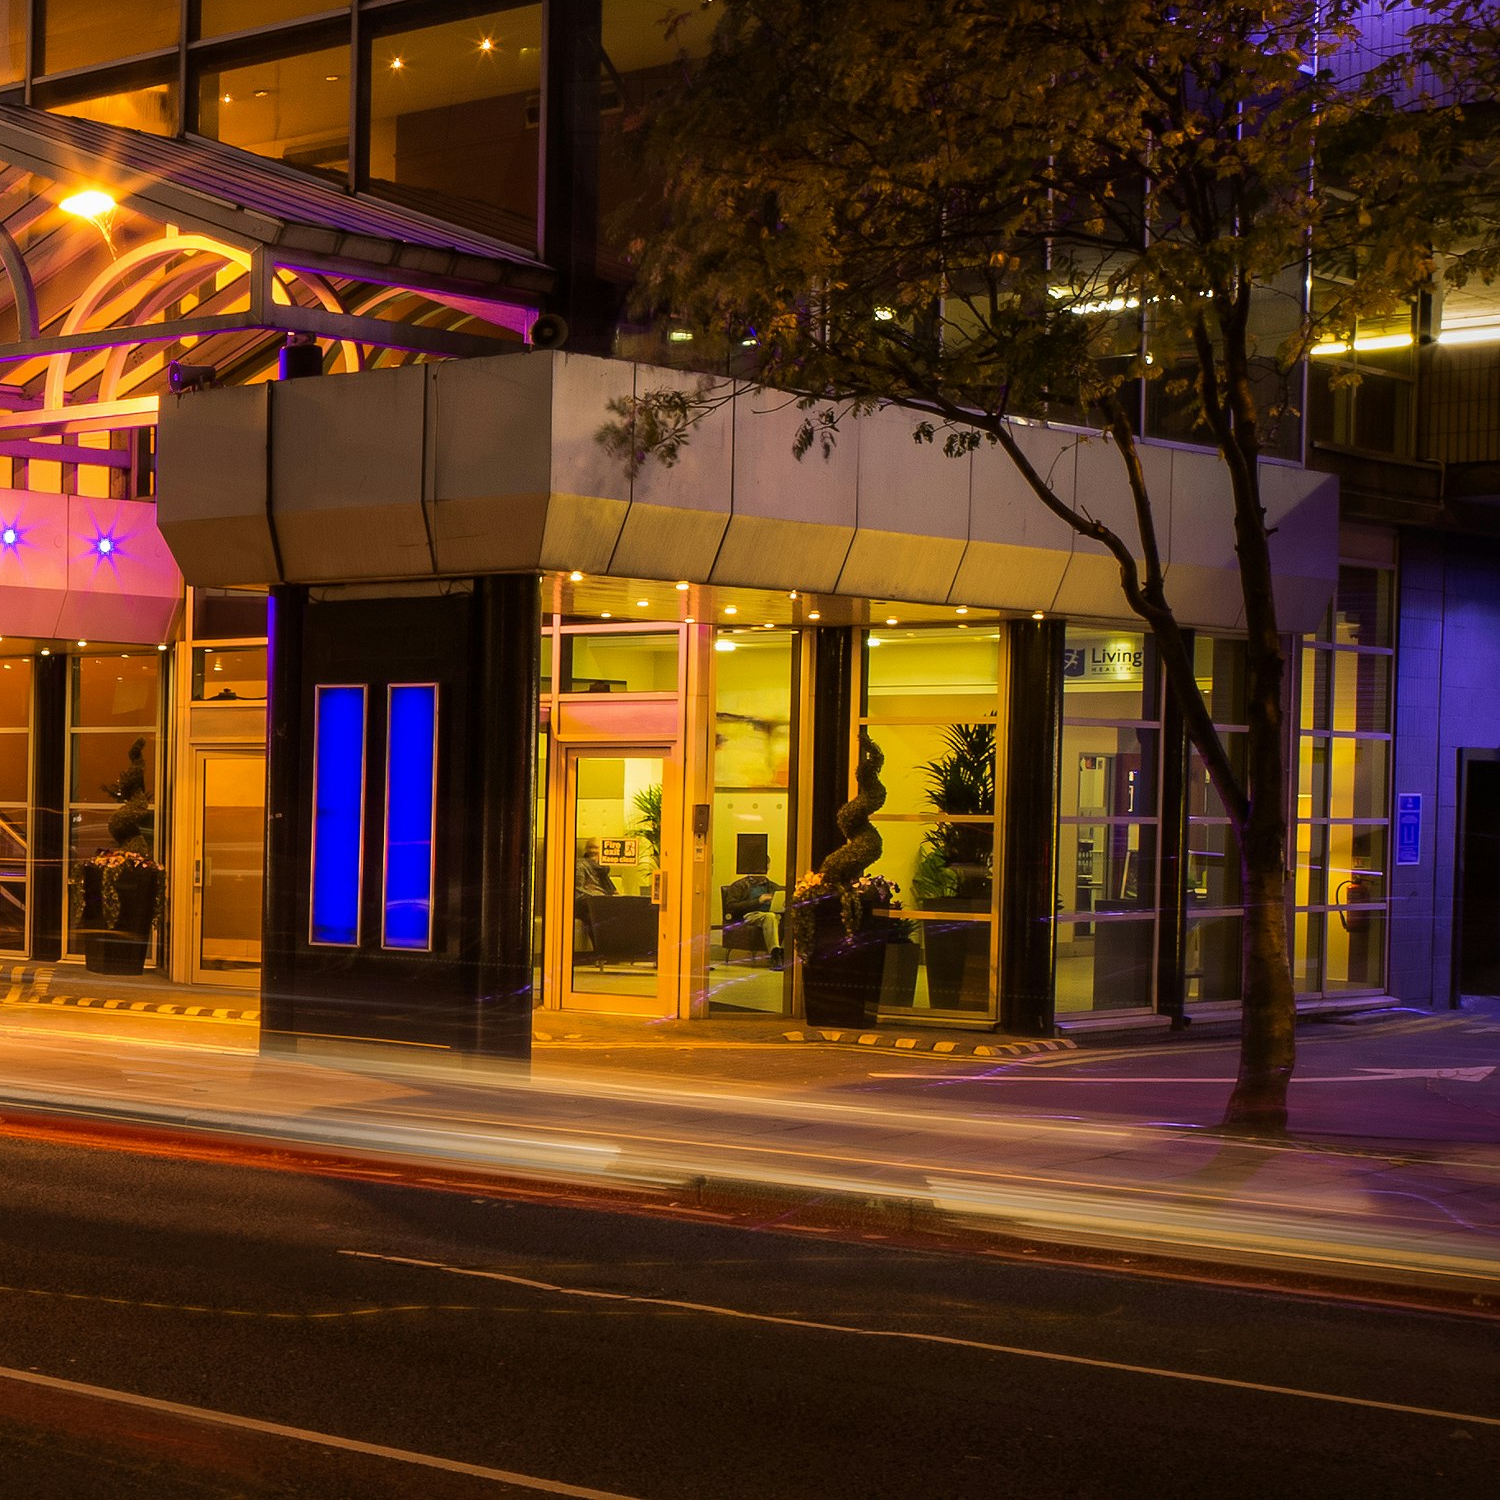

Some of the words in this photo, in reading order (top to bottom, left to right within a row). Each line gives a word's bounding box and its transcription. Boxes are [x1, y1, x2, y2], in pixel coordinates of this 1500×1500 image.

[1092, 648, 1143, 667] Living
[604, 841, 621, 849] Fire
[603, 847, 620, 855] exit
